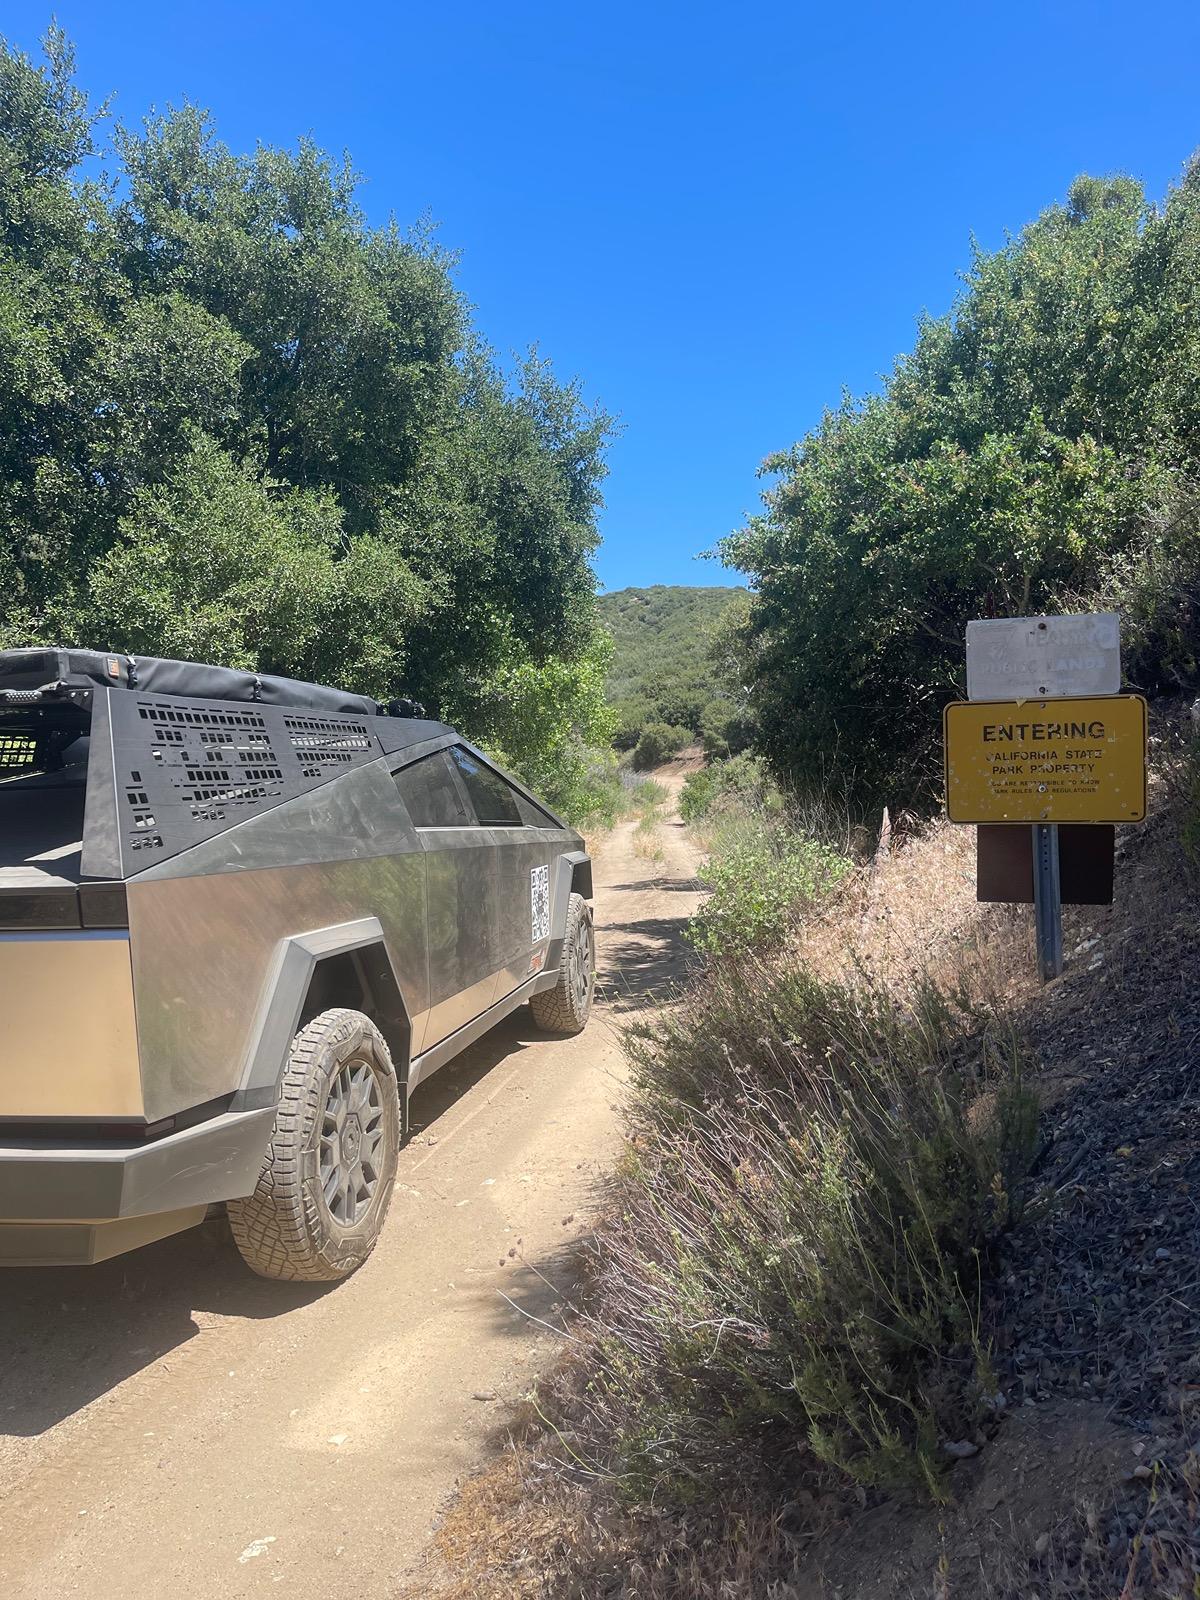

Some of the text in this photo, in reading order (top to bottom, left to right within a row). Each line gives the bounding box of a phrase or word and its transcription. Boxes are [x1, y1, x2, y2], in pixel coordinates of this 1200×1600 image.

[983, 721, 1105, 742] ENTERING
[986, 749, 1103, 762] CALIFORNIA STATE
[992, 763, 1095, 775] PARK PROPERTY
